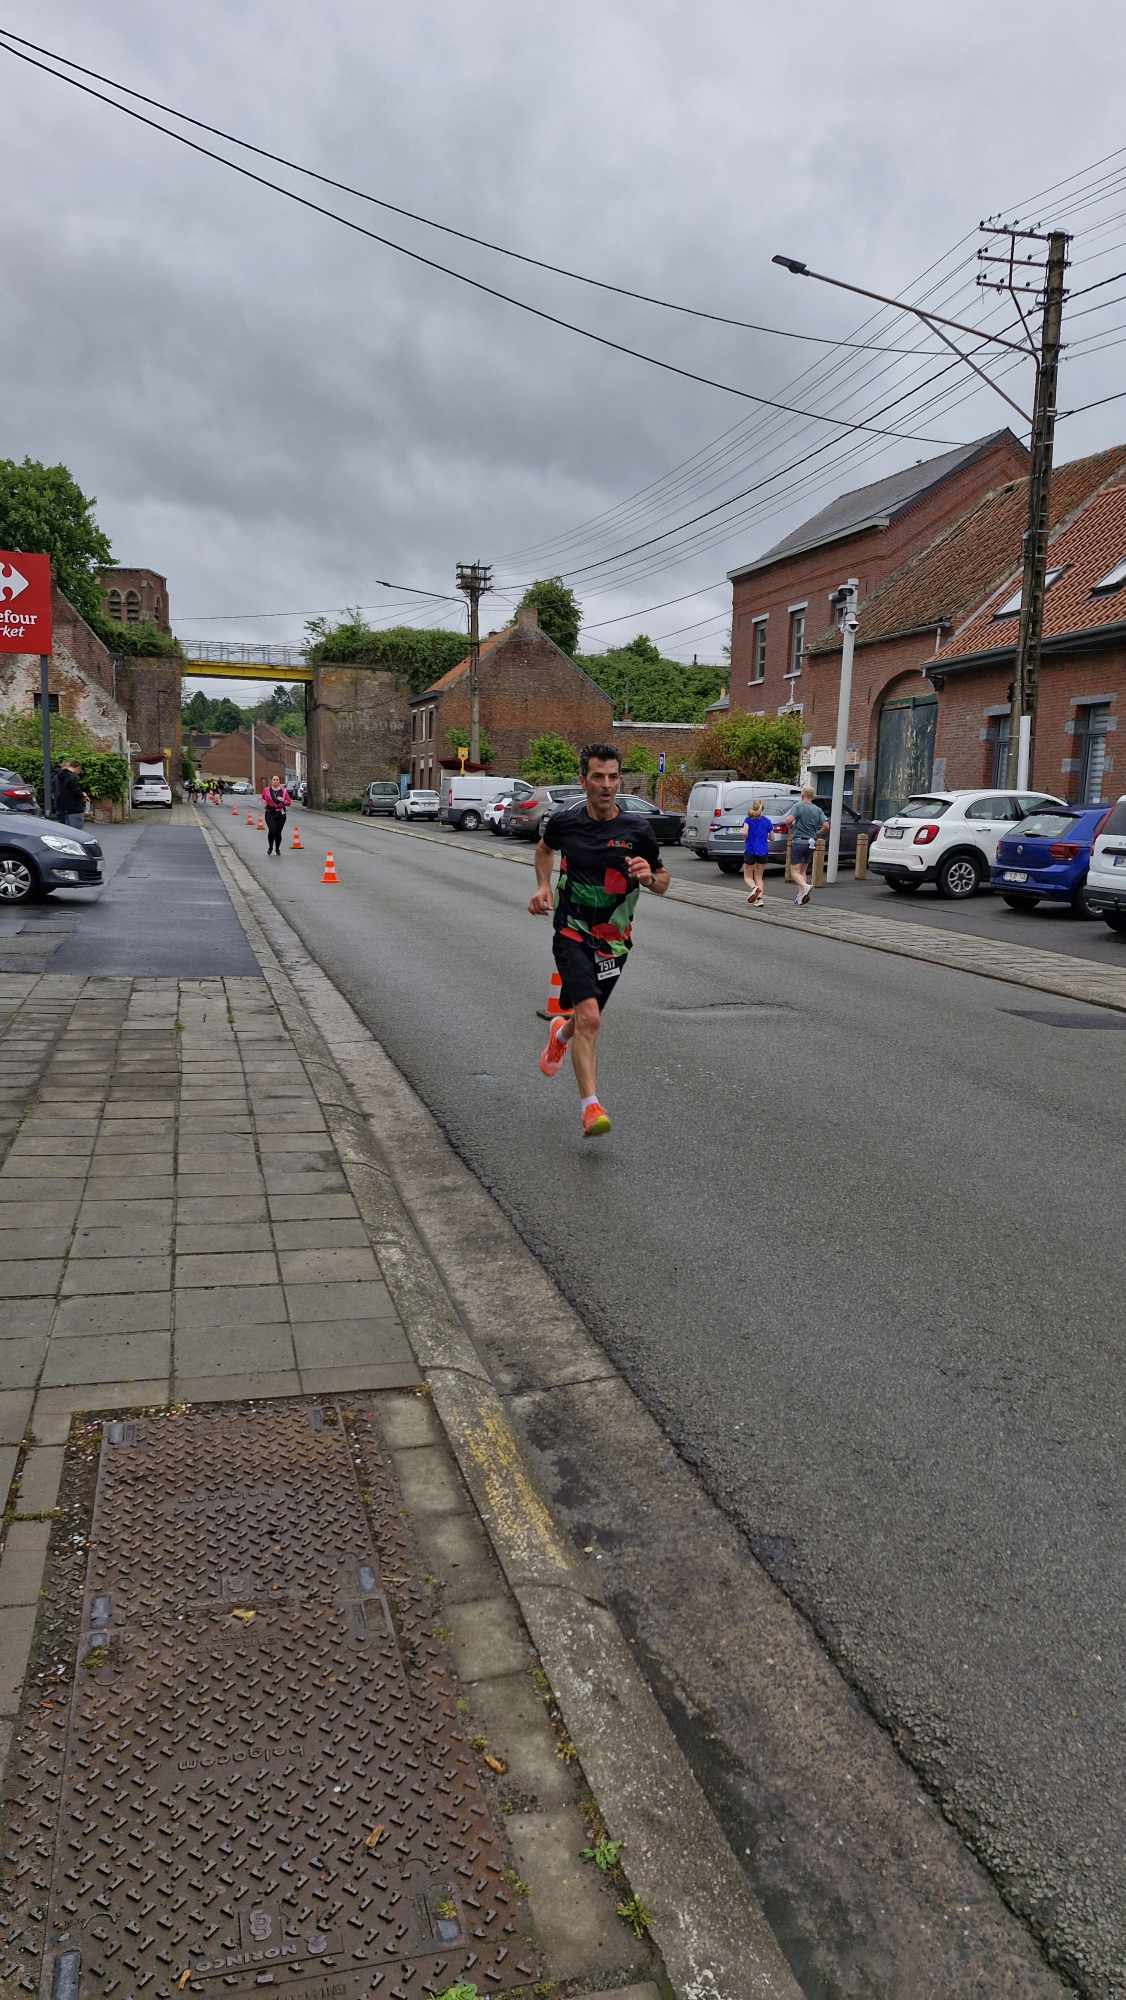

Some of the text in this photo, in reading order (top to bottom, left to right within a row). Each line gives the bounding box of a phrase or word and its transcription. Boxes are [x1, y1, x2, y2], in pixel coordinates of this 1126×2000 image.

[598, 958, 616, 972] 7517
[177, 1743, 304, 1771] belgacom
[195, 1943, 297, 1972] NORINCO
